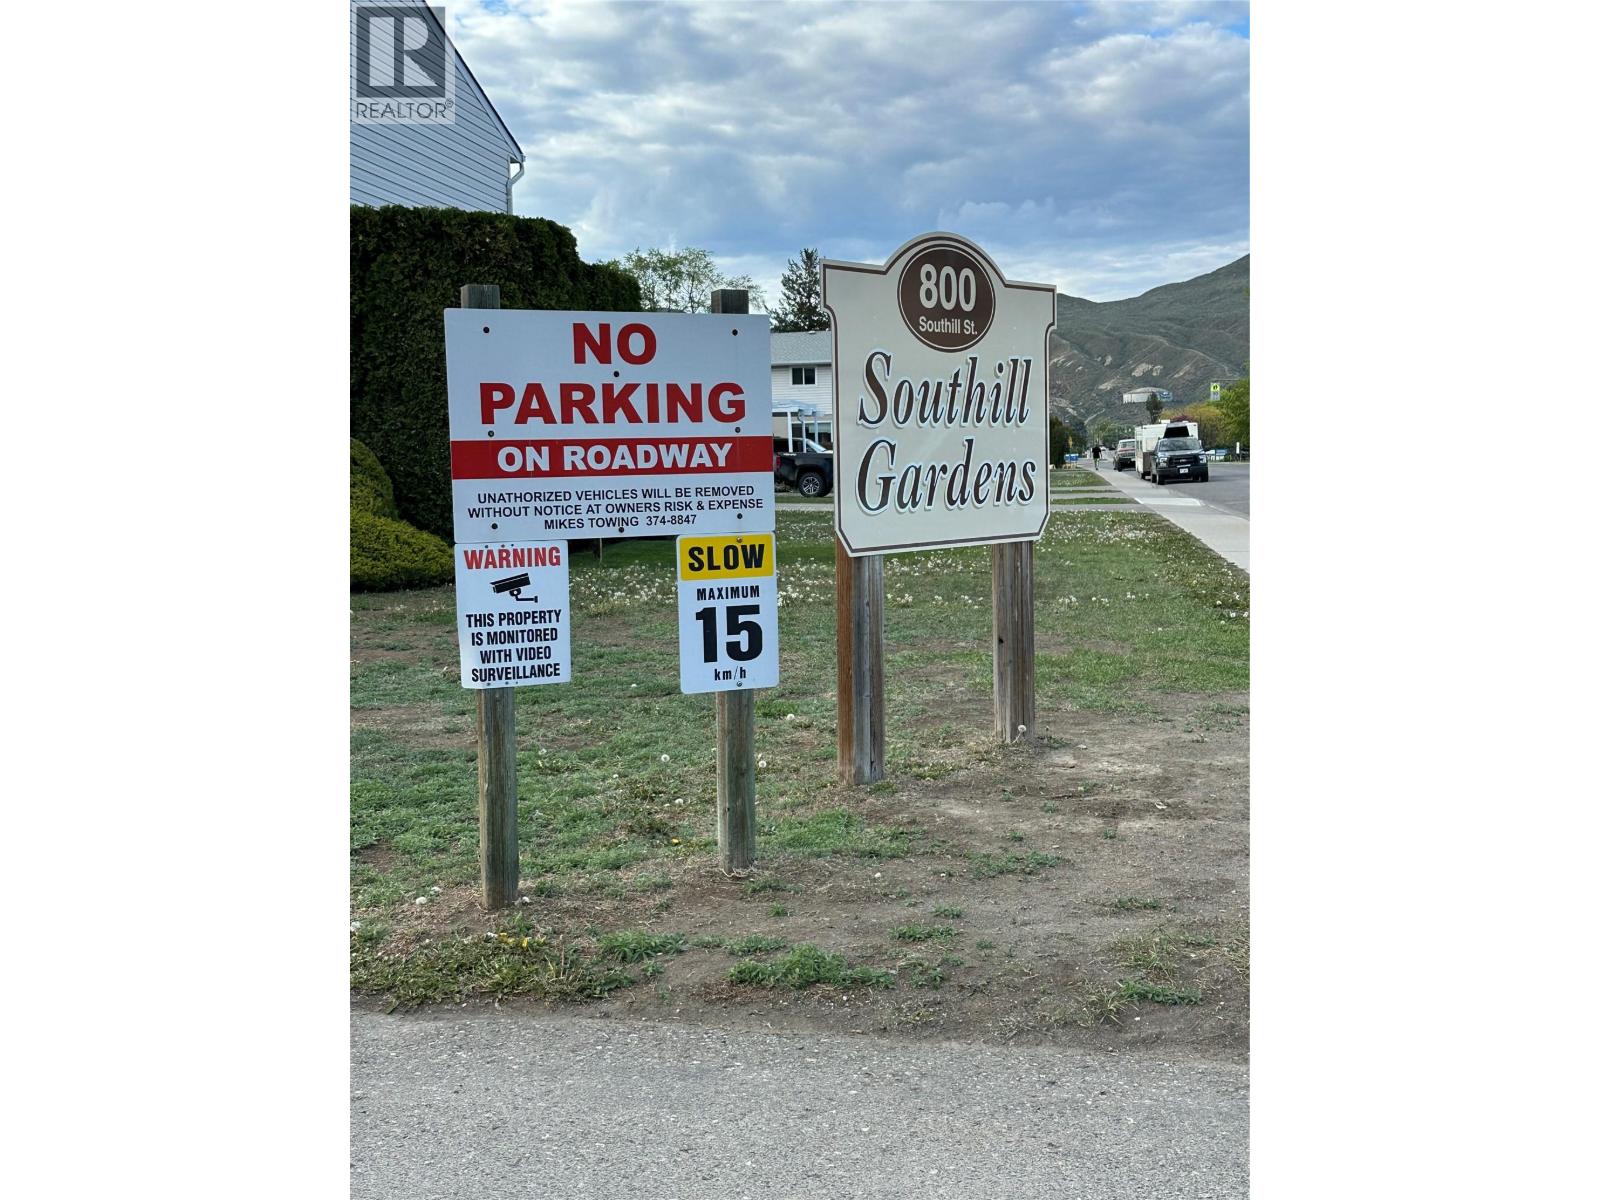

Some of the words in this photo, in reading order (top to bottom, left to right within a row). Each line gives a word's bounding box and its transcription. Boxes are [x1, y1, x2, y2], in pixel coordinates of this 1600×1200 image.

[919, 263, 977, 312] 800
[919, 316, 961, 335] Southill
[963, 321, 978, 335] St.
[572, 322, 657, 365] NO
[858, 351, 1032, 425] Southill
[479, 382, 746, 425] PARKING
[497, 446, 550, 472] ON
[563, 442, 733, 471] ROADWAY
[857, 438, 1037, 511] Gardens
[477, 491, 572, 504] UNATHORIZED
[575, 488, 638, 502] VEHICLES
[641, 487, 672, 500] WILL
[675, 486, 692, 498] BE
[695, 485, 754, 497] REMOVED
[467, 505, 531, 518] WITHOUT
[534, 504, 582, 517] NOTICE
[585, 503, 602, 515] AT
[605, 502, 661, 514] OWNERS
[664, 500, 693, 512] RISK
[696, 500, 705, 511] &
[708, 498, 764, 511] EXPENSE
[544, 518, 585, 530] MIKES
[588, 516, 639, 528] TOWING
[646, 514, 697, 526] 374-8847
[463, 546, 561, 570] WARNING
[688, 543, 765, 572] SLOW
[696, 585, 760, 601] MAXIMUM
[466, 613, 495, 628] THIS
[498, 609, 562, 627] PROPERTY
[471, 632, 484, 646] IS
[487, 628, 558, 645] MONITORED
[695, 604, 763, 663] 15
[480, 649, 512, 664] WITH
[516, 645, 552, 662] VIDEO
[471, 663, 561, 683] SURVEILLANCE
[714, 665, 747, 681] km/h
